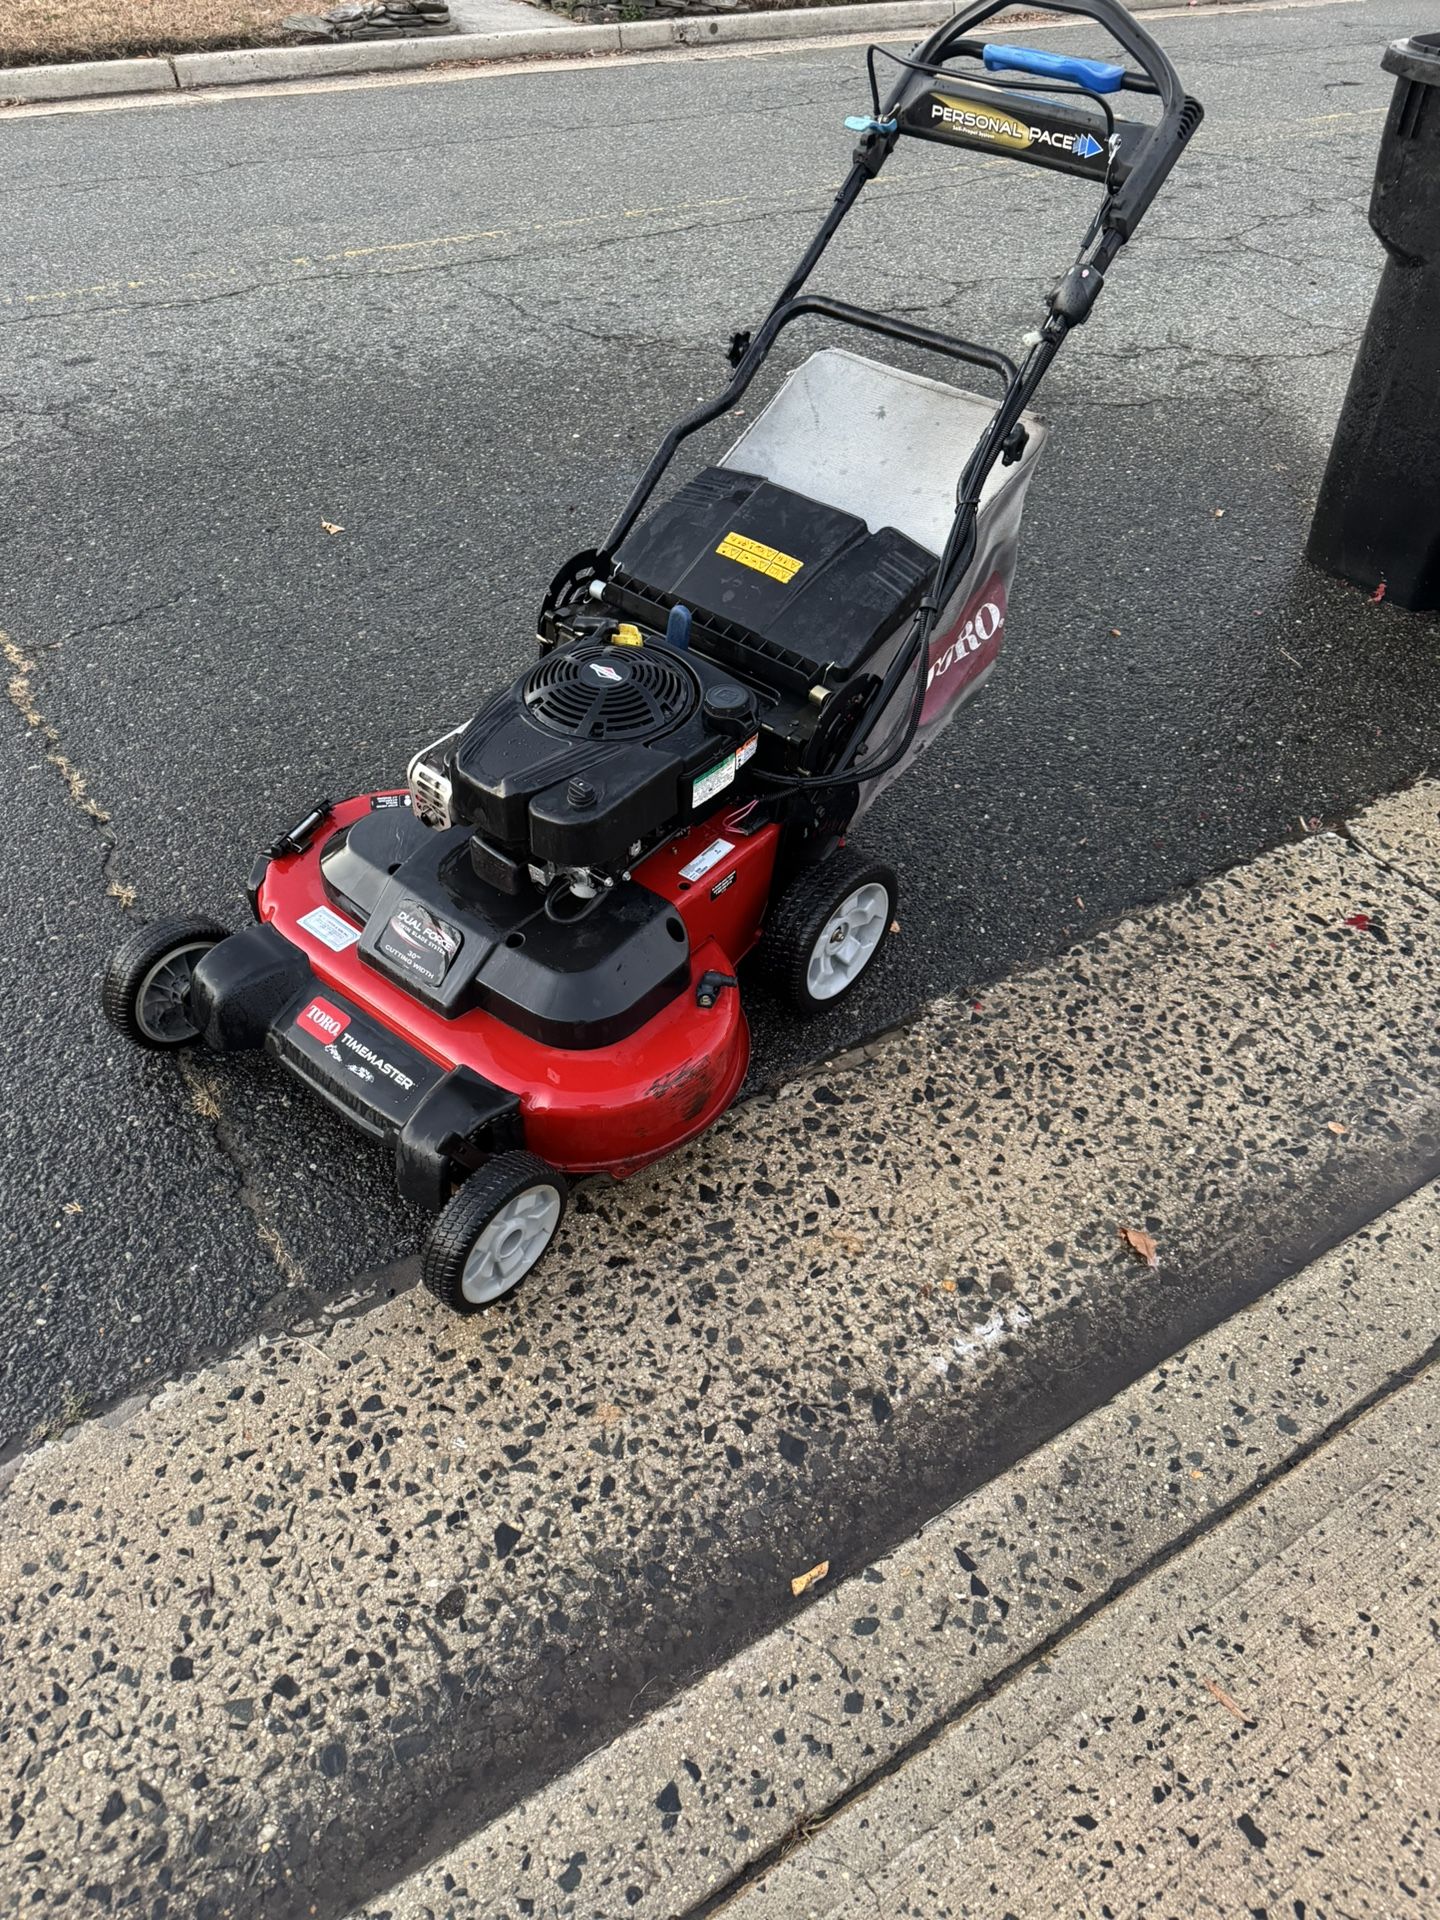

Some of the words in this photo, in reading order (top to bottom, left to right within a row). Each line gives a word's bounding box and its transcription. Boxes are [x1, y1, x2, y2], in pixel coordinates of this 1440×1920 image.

[931, 104, 1023, 138] PERSONAL
[1028, 126, 1075, 151] PACE
[397, 911, 423, 931] DUAL
[423, 928, 453, 952] FORCE
[411, 930, 428, 944] BLADE
[428, 941, 446, 955] SYSTEM
[385, 944, 413, 965] CUTTING
[413, 962, 434, 979] WIDTH
[306, 1004, 342, 1036] TORO
[341, 1032, 415, 1090] TIMEMASTER
